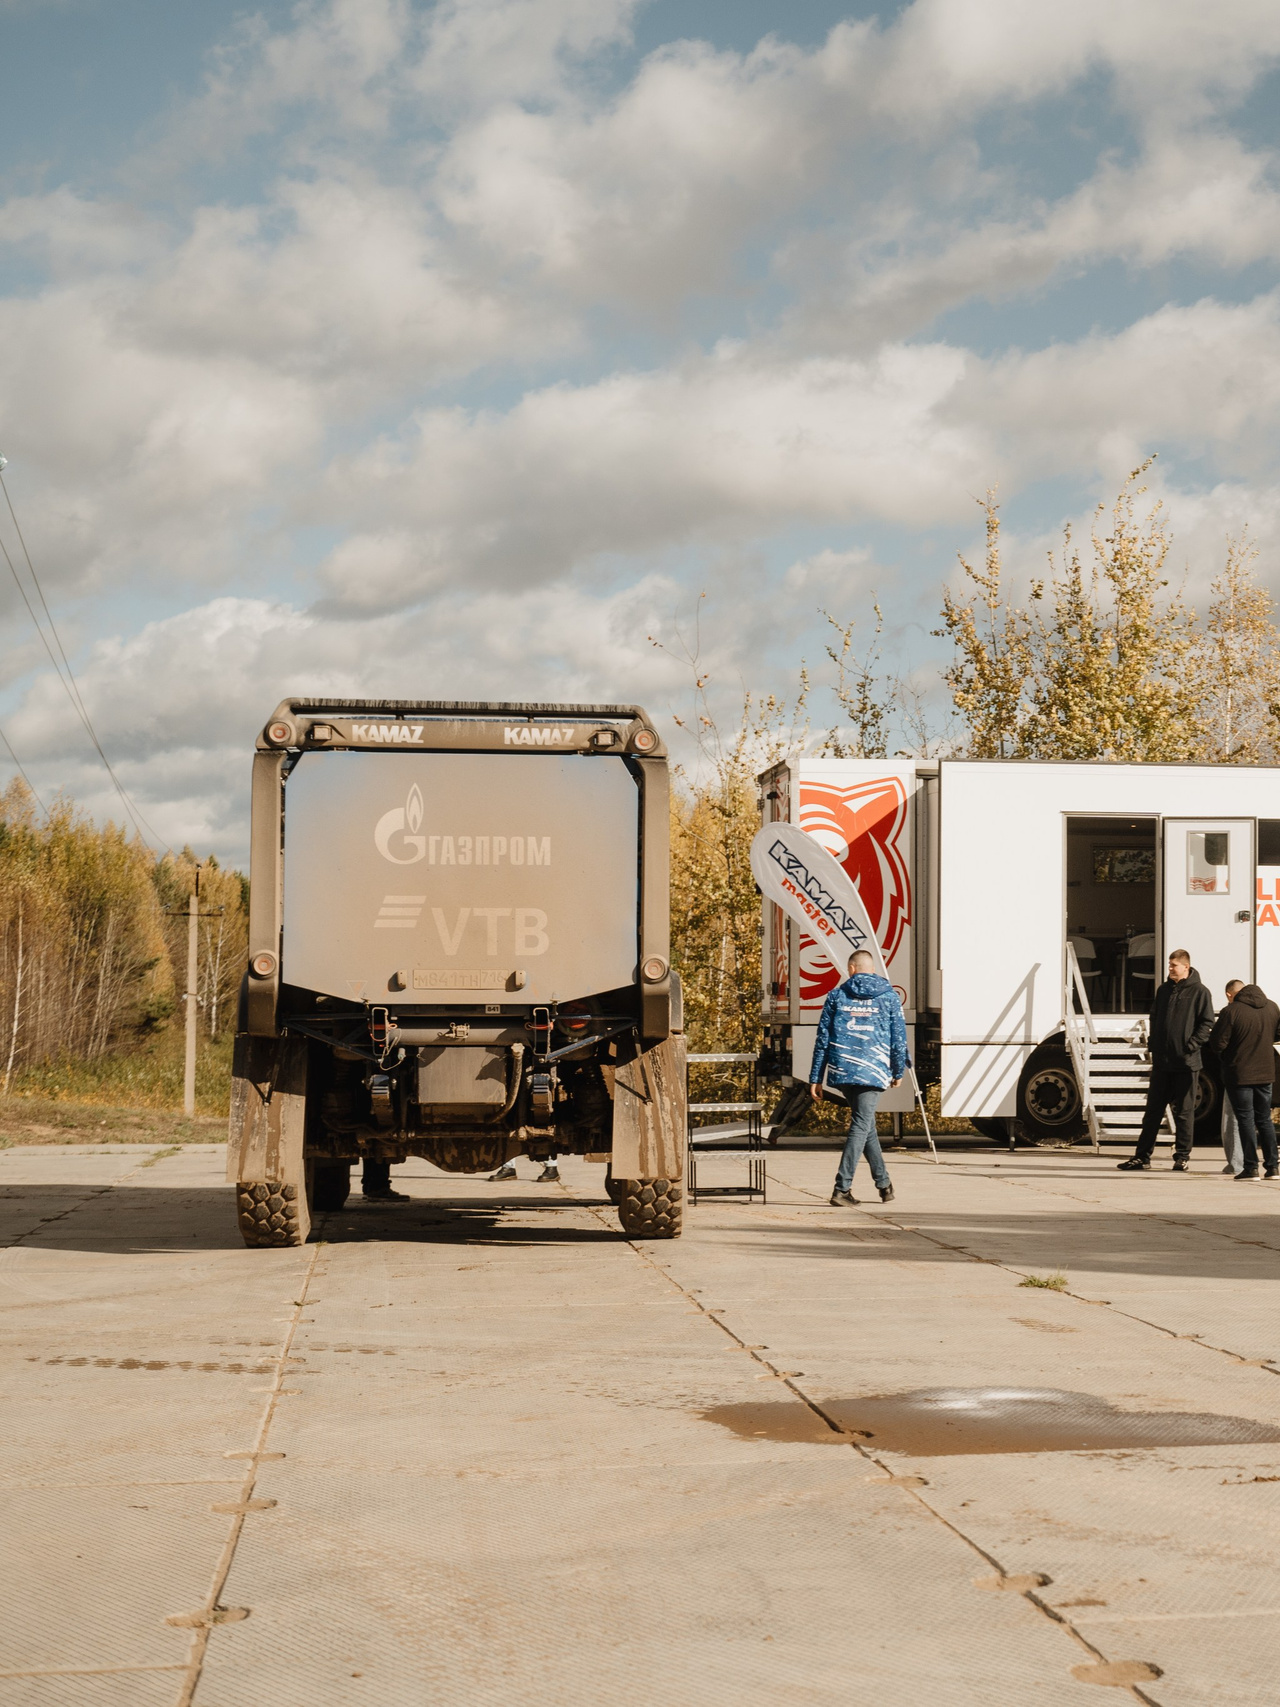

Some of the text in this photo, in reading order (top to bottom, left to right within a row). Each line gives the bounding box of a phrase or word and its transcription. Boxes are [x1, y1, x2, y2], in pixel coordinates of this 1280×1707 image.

[351, 724, 424, 743] KAMAZ
[503, 727, 575, 745] KAMAZ
[428, 836, 551, 866] ГАЗПРОМ
[768, 839, 867, 949] KAMAZ
[780, 878, 837, 937] master
[431, 907, 550, 956] VTB
